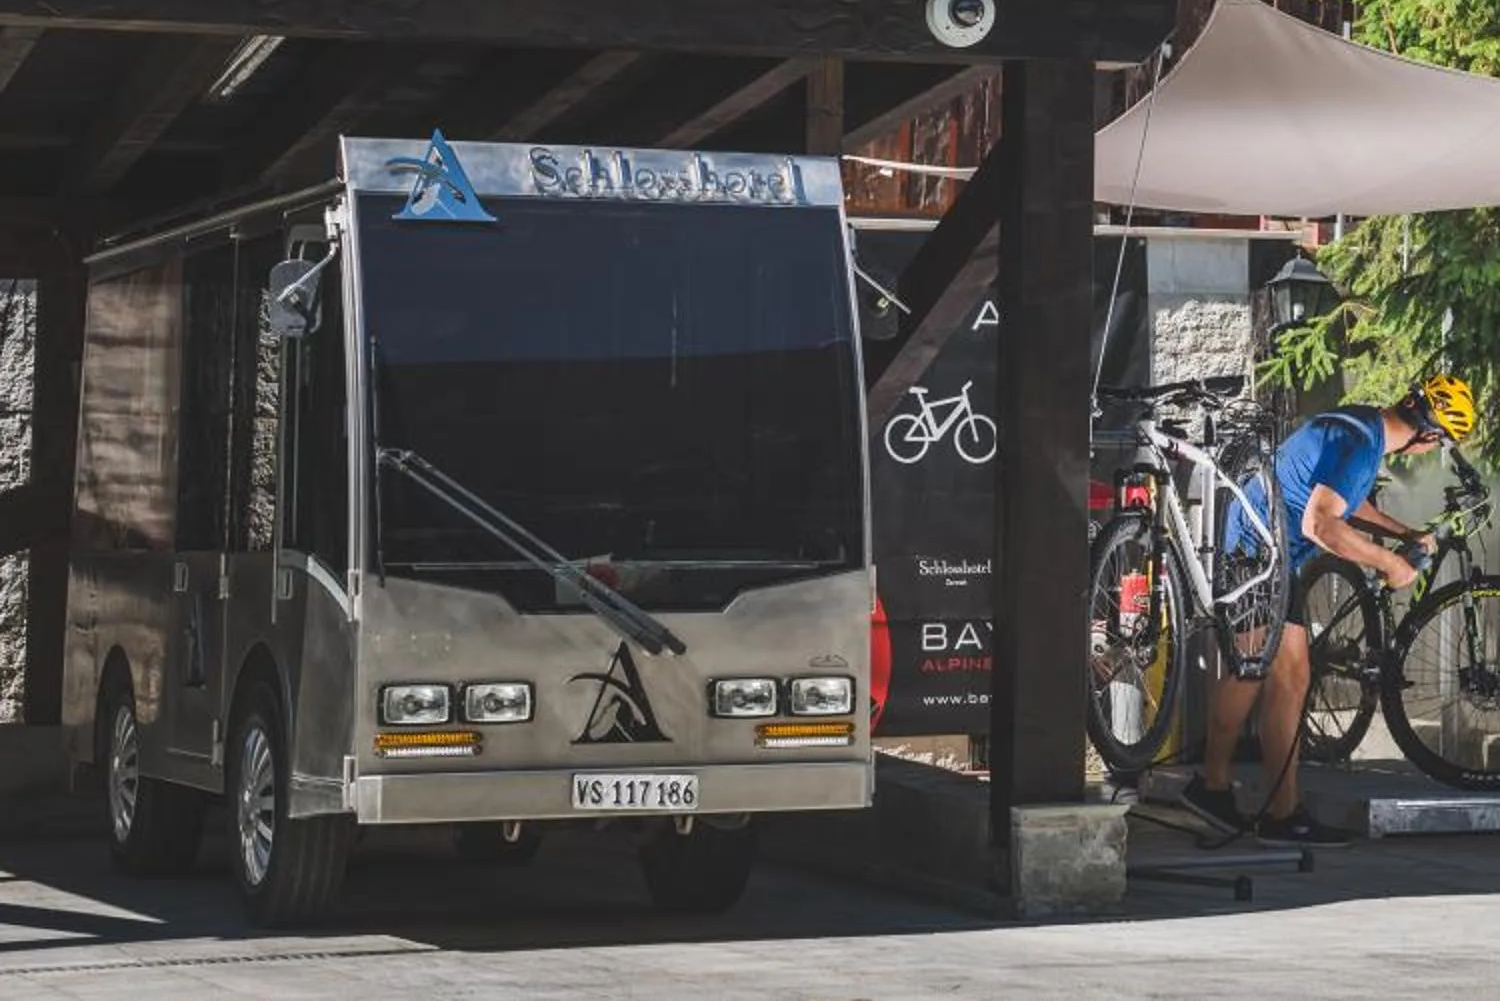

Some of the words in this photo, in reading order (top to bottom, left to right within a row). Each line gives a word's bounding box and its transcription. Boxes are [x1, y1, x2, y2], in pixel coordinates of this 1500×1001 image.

[528, 146, 806, 205] Schlosshotel
[922, 622, 993, 651] BA
[922, 692, 992, 705] www.ba
[577, 780, 603, 804] VS
[612, 780, 650, 805] 117
[657, 781, 695, 806] 186
